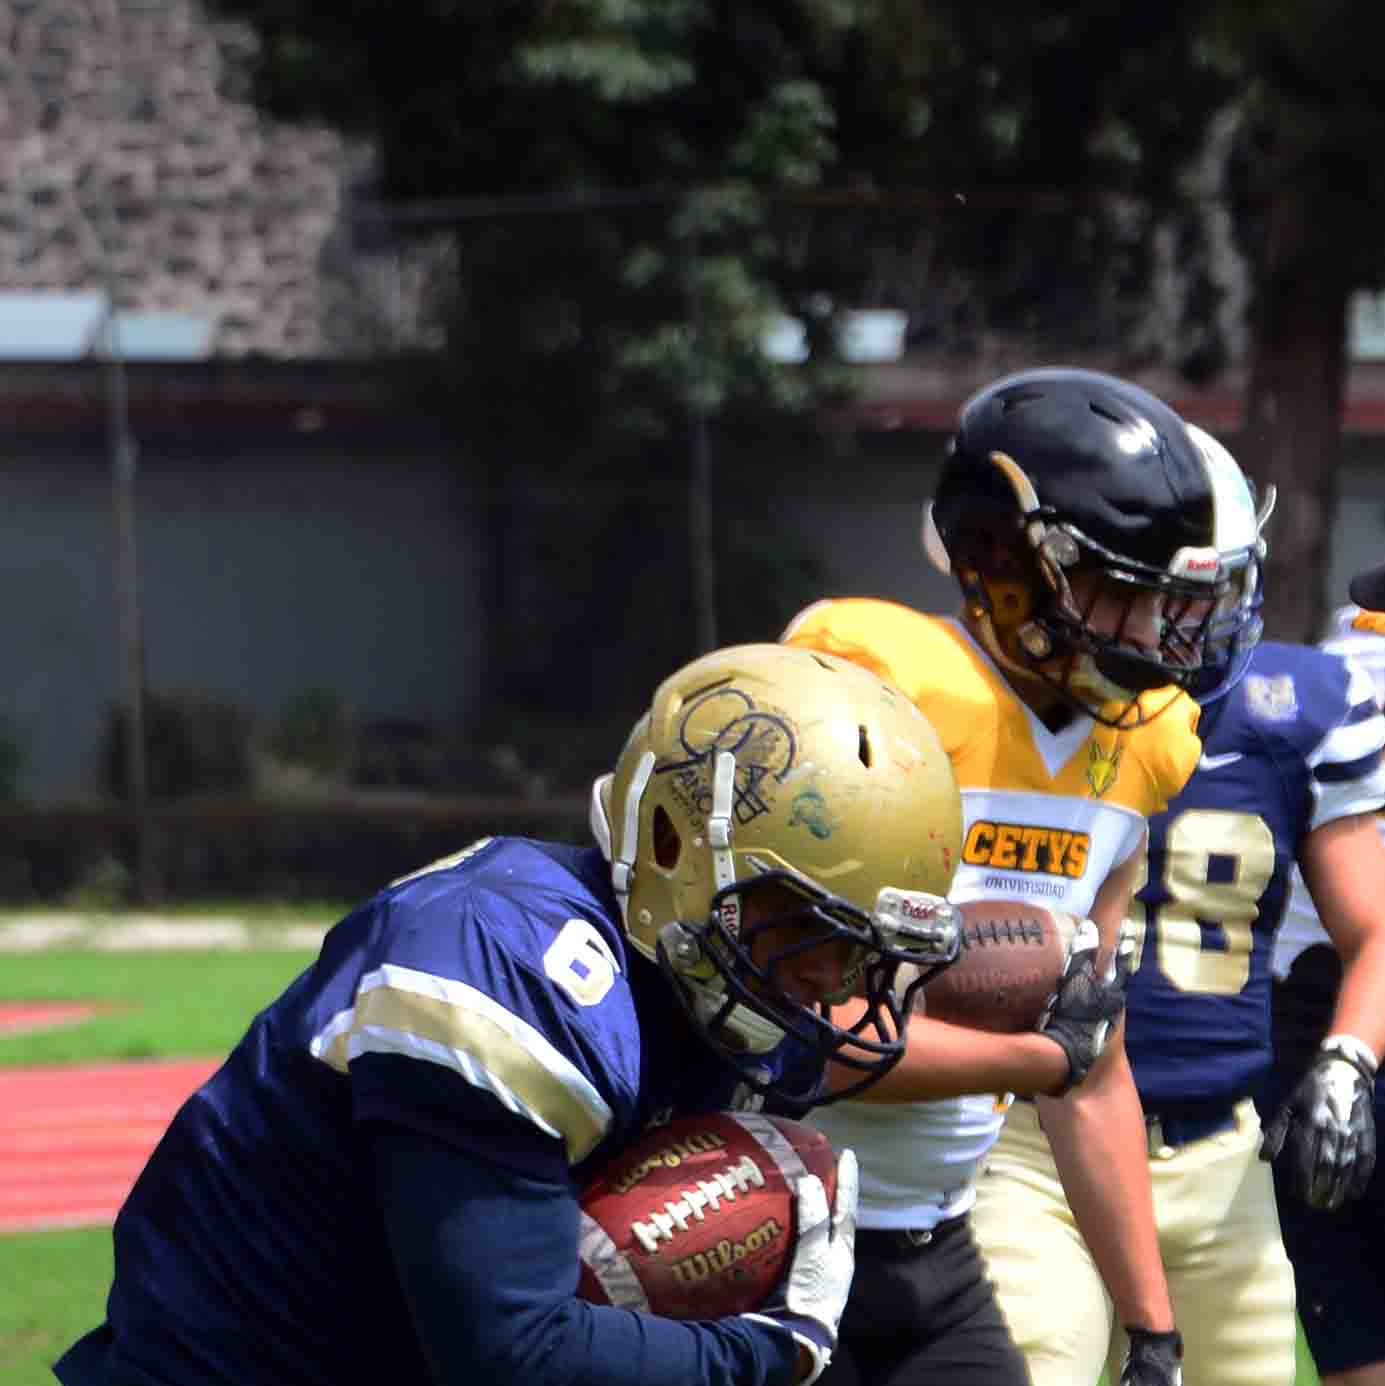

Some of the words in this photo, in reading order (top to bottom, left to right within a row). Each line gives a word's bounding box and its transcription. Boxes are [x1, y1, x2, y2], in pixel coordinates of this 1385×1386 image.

[961, 819, 1090, 880] CETYS
[1128, 809, 1276, 994] 8
[671, 1217, 783, 1283] Wilson
